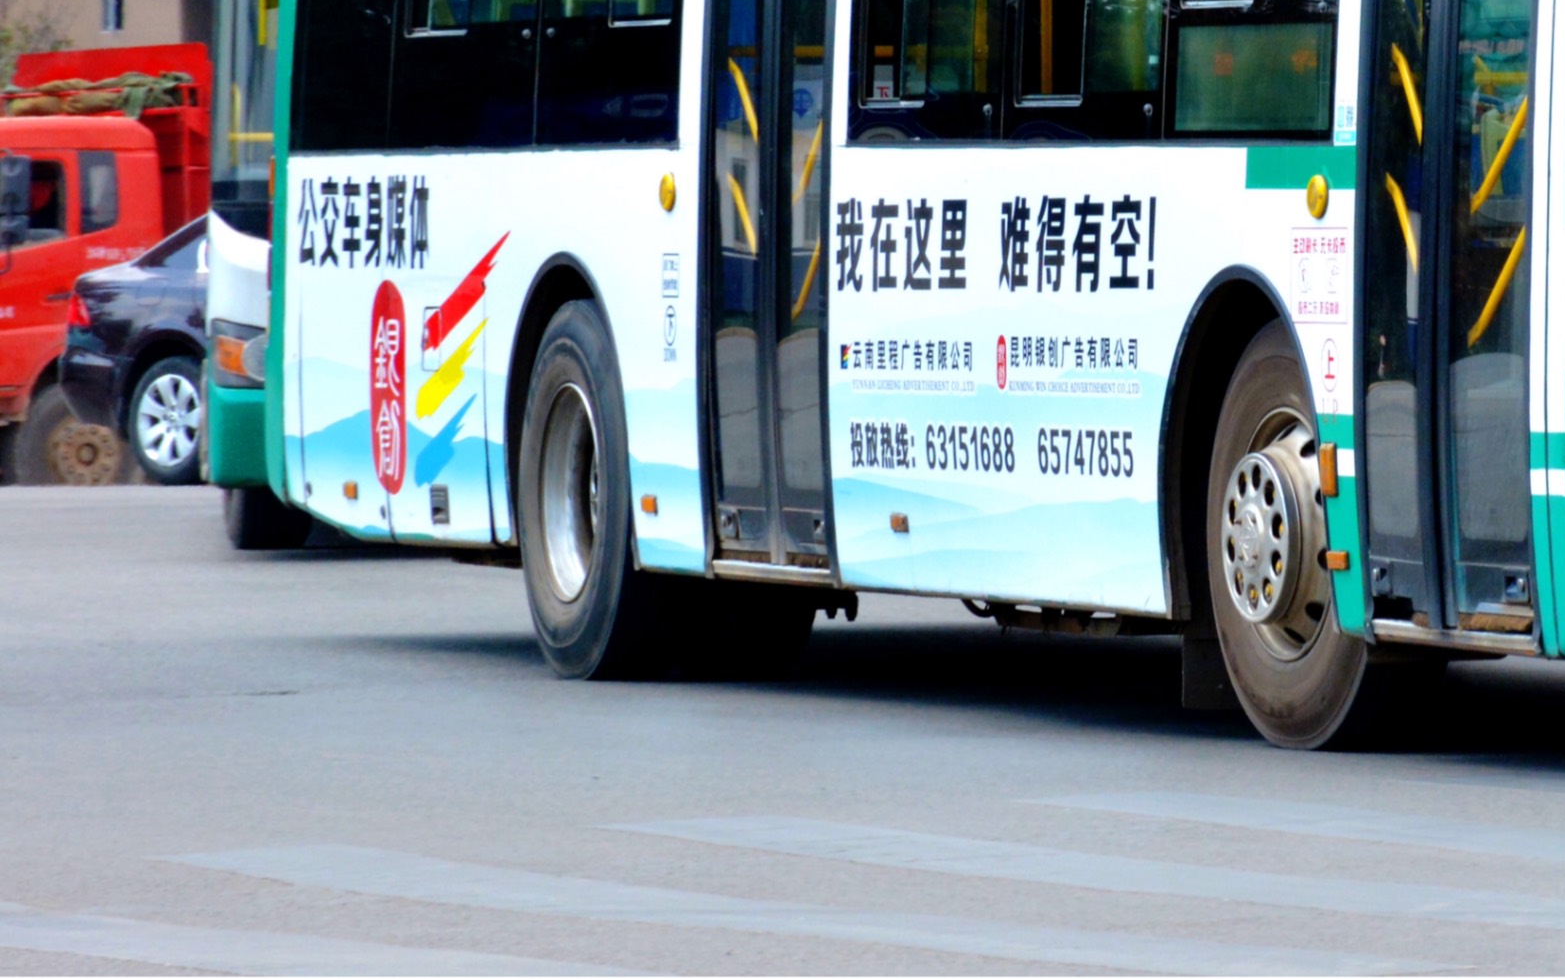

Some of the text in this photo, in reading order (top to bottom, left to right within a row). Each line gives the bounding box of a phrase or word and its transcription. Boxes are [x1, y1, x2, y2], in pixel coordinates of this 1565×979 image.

[298, 175, 430, 269] 公交车身媒体
[836, 197, 968, 293] 我在这里
[852, 339, 973, 372] 云南里程广告有限公司
[1010, 336, 1138, 370] 昆明银创广告有限公司
[1324, 349, 1335, 379] 上
[925, 424, 1015, 473] 63151688
[1037, 427, 1134, 478] 65747855
